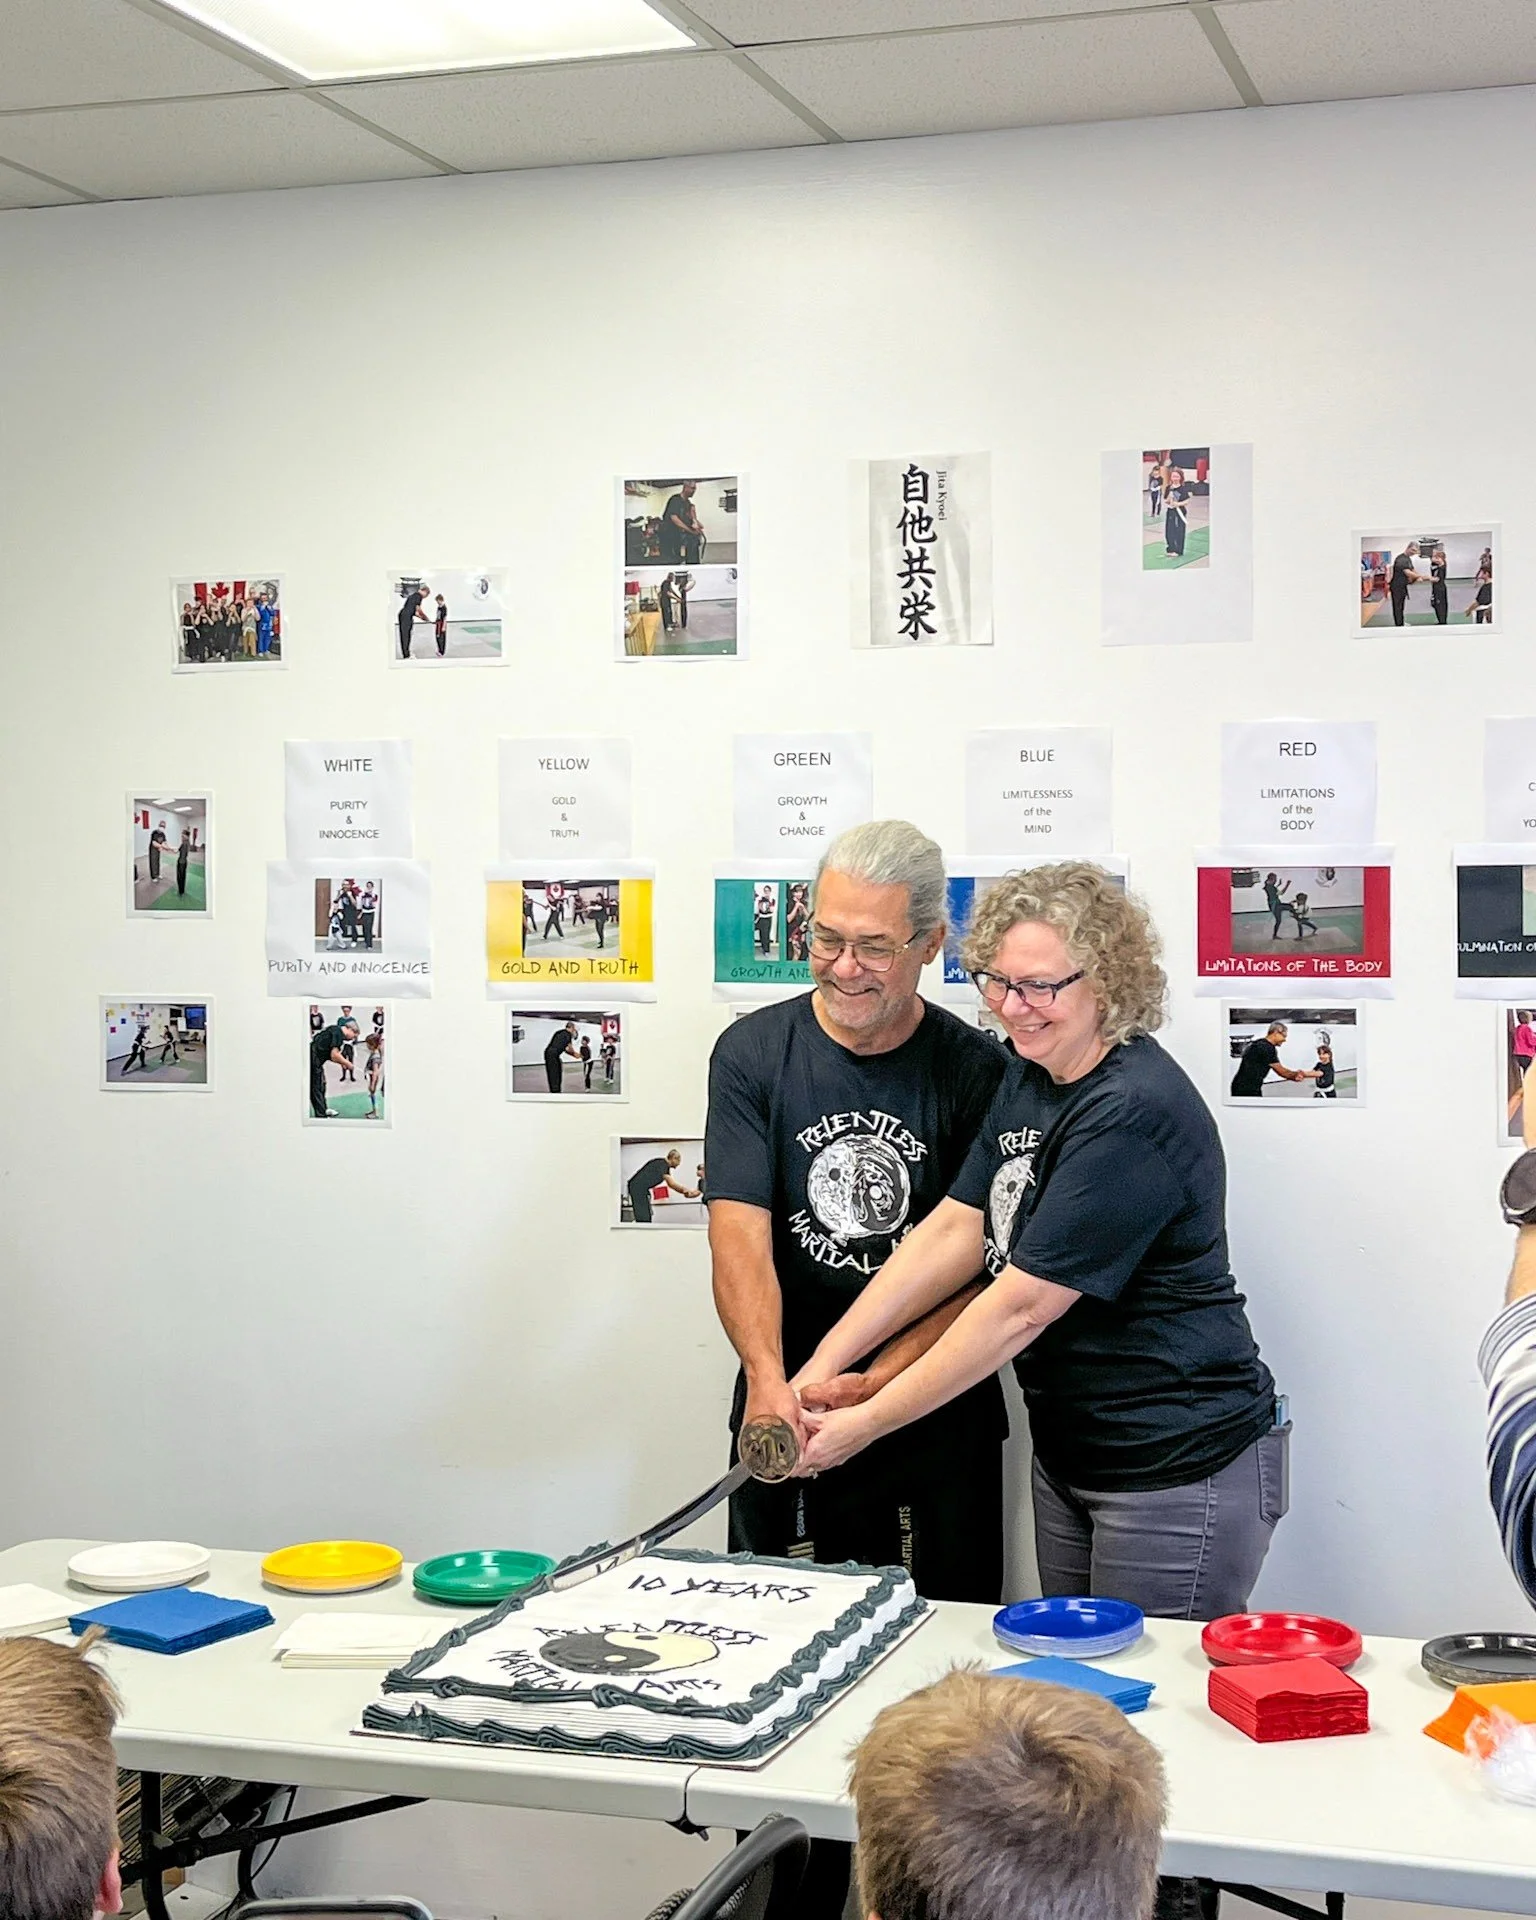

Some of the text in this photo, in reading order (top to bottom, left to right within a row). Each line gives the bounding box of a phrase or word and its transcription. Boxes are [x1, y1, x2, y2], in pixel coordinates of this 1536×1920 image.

[936, 470, 948, 521] Jita Kyoei
[896, 463, 938, 641] 自他共栄
[1019, 749, 1056, 763] BLUE
[1278, 742, 1317, 757] RED
[323, 758, 373, 773] WHITE
[537, 757, 590, 771] YELLOW
[773, 752, 832, 767] GREEN
[1002, 789, 1074, 800] LIMITLESSNESS
[1260, 788, 1336, 799] LIMITATIONS
[329, 800, 368, 811] PURITY
[551, 796, 577, 806] GOLD
[777, 795, 828, 807] GROWTH
[1023, 806, 1052, 817] of the
[1282, 804, 1313, 815] of the
[345, 815, 353, 825] &
[560, 813, 568, 822] &
[798, 811, 806, 822] &
[779, 825, 826, 836] CHANGE
[1024, 824, 1052, 834] MIND
[1280, 820, 1315, 831] BODY
[318, 828, 380, 840] INNOCENCE
[550, 829, 579, 839] TRUTH
[318, 962, 346, 975] AND
[501, 958, 639, 977] GOLD AND TRUTH
[730, 964, 782, 979] GROWTH
[1286, 960, 1307, 972] OF
[1311, 957, 1340, 973] THE
[1344, 959, 1383, 973] BODY
[796, 1109, 928, 1162] RELENTLESS
[788, 1209, 883, 1275] MARTIAL
[899, 1505, 912, 1531] ARTS
[628, 1574, 818, 1604] 10 YEARS
[633, 1678, 722, 1695] ARTS
